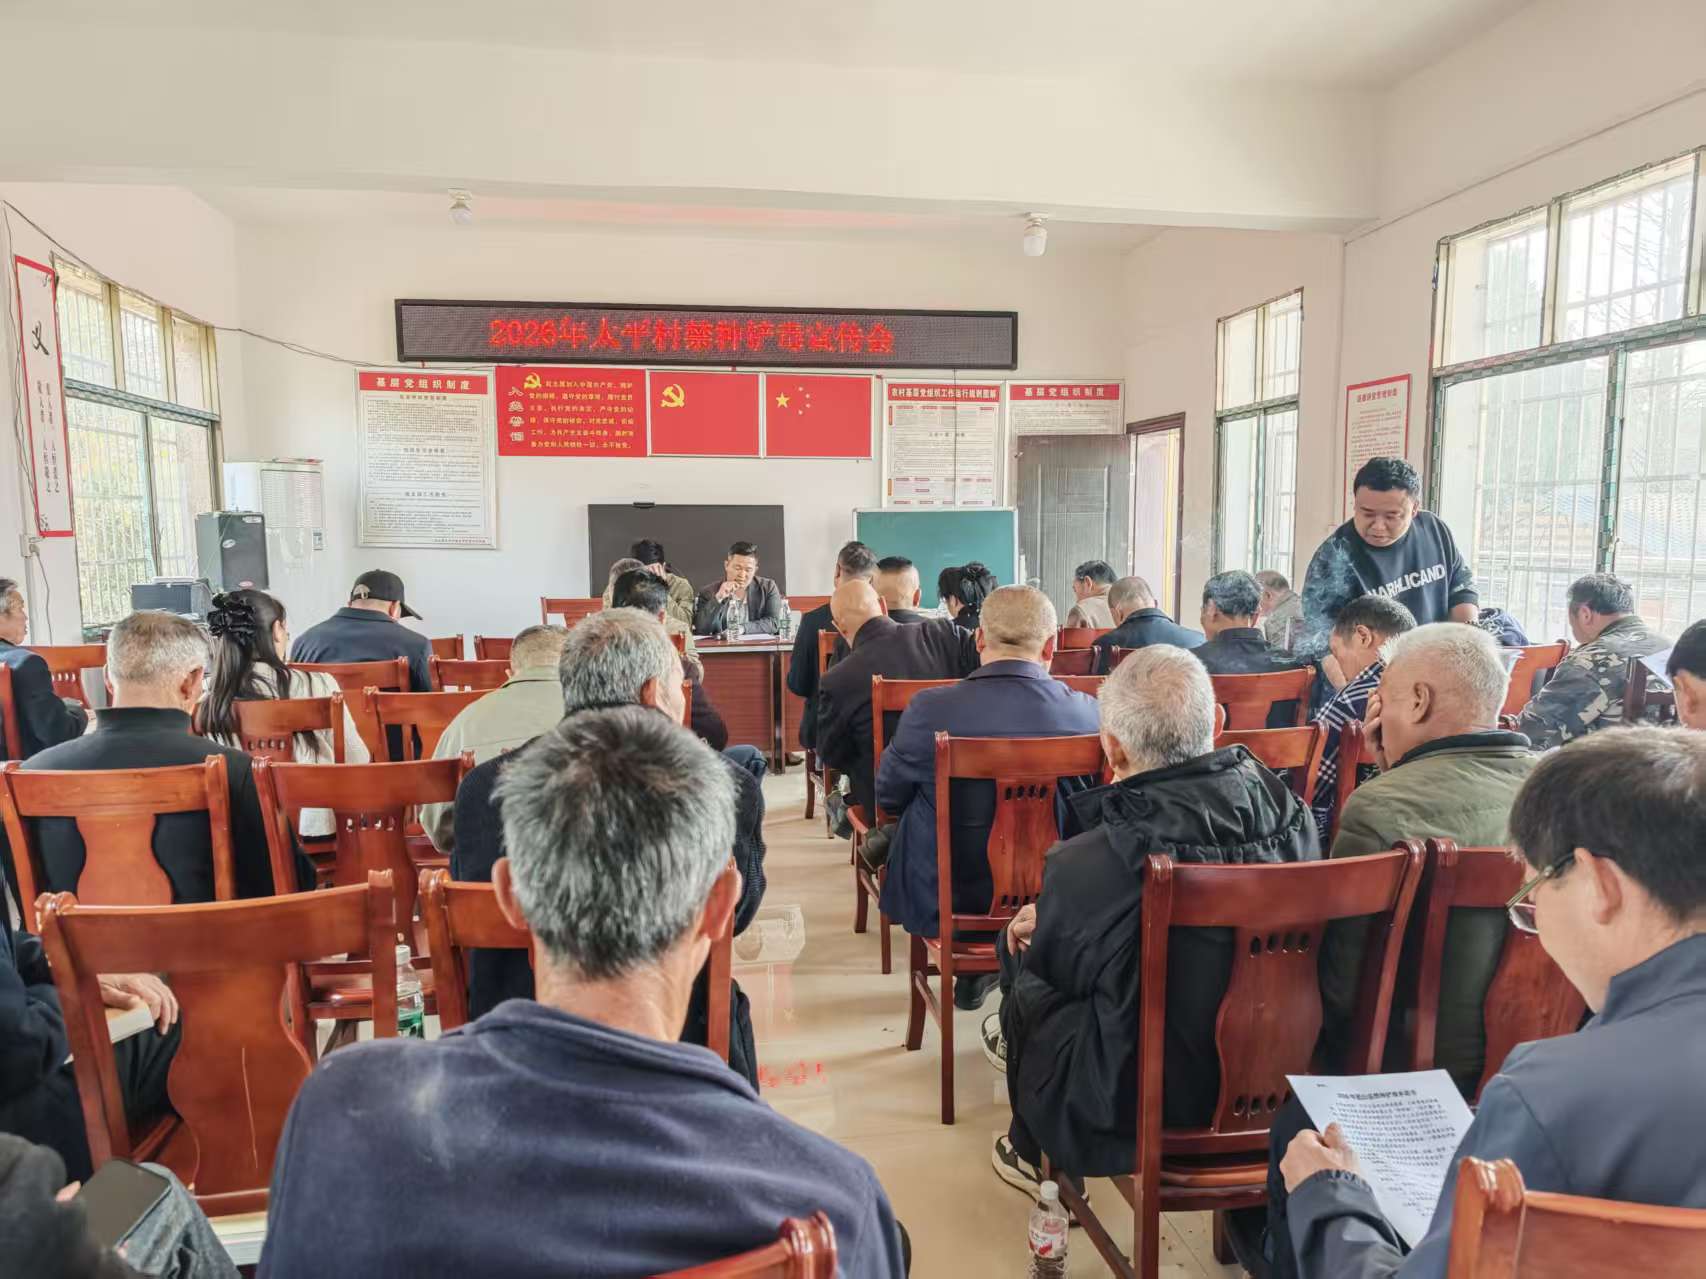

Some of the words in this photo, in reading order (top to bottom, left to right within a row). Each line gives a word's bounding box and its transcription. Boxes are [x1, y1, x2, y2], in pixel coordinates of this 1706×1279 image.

[376, 377, 471, 390] 基层党组织制度
[1024, 387, 1105, 397] 基层党组织制度
[507, 386, 525, 442] 入党誓词
